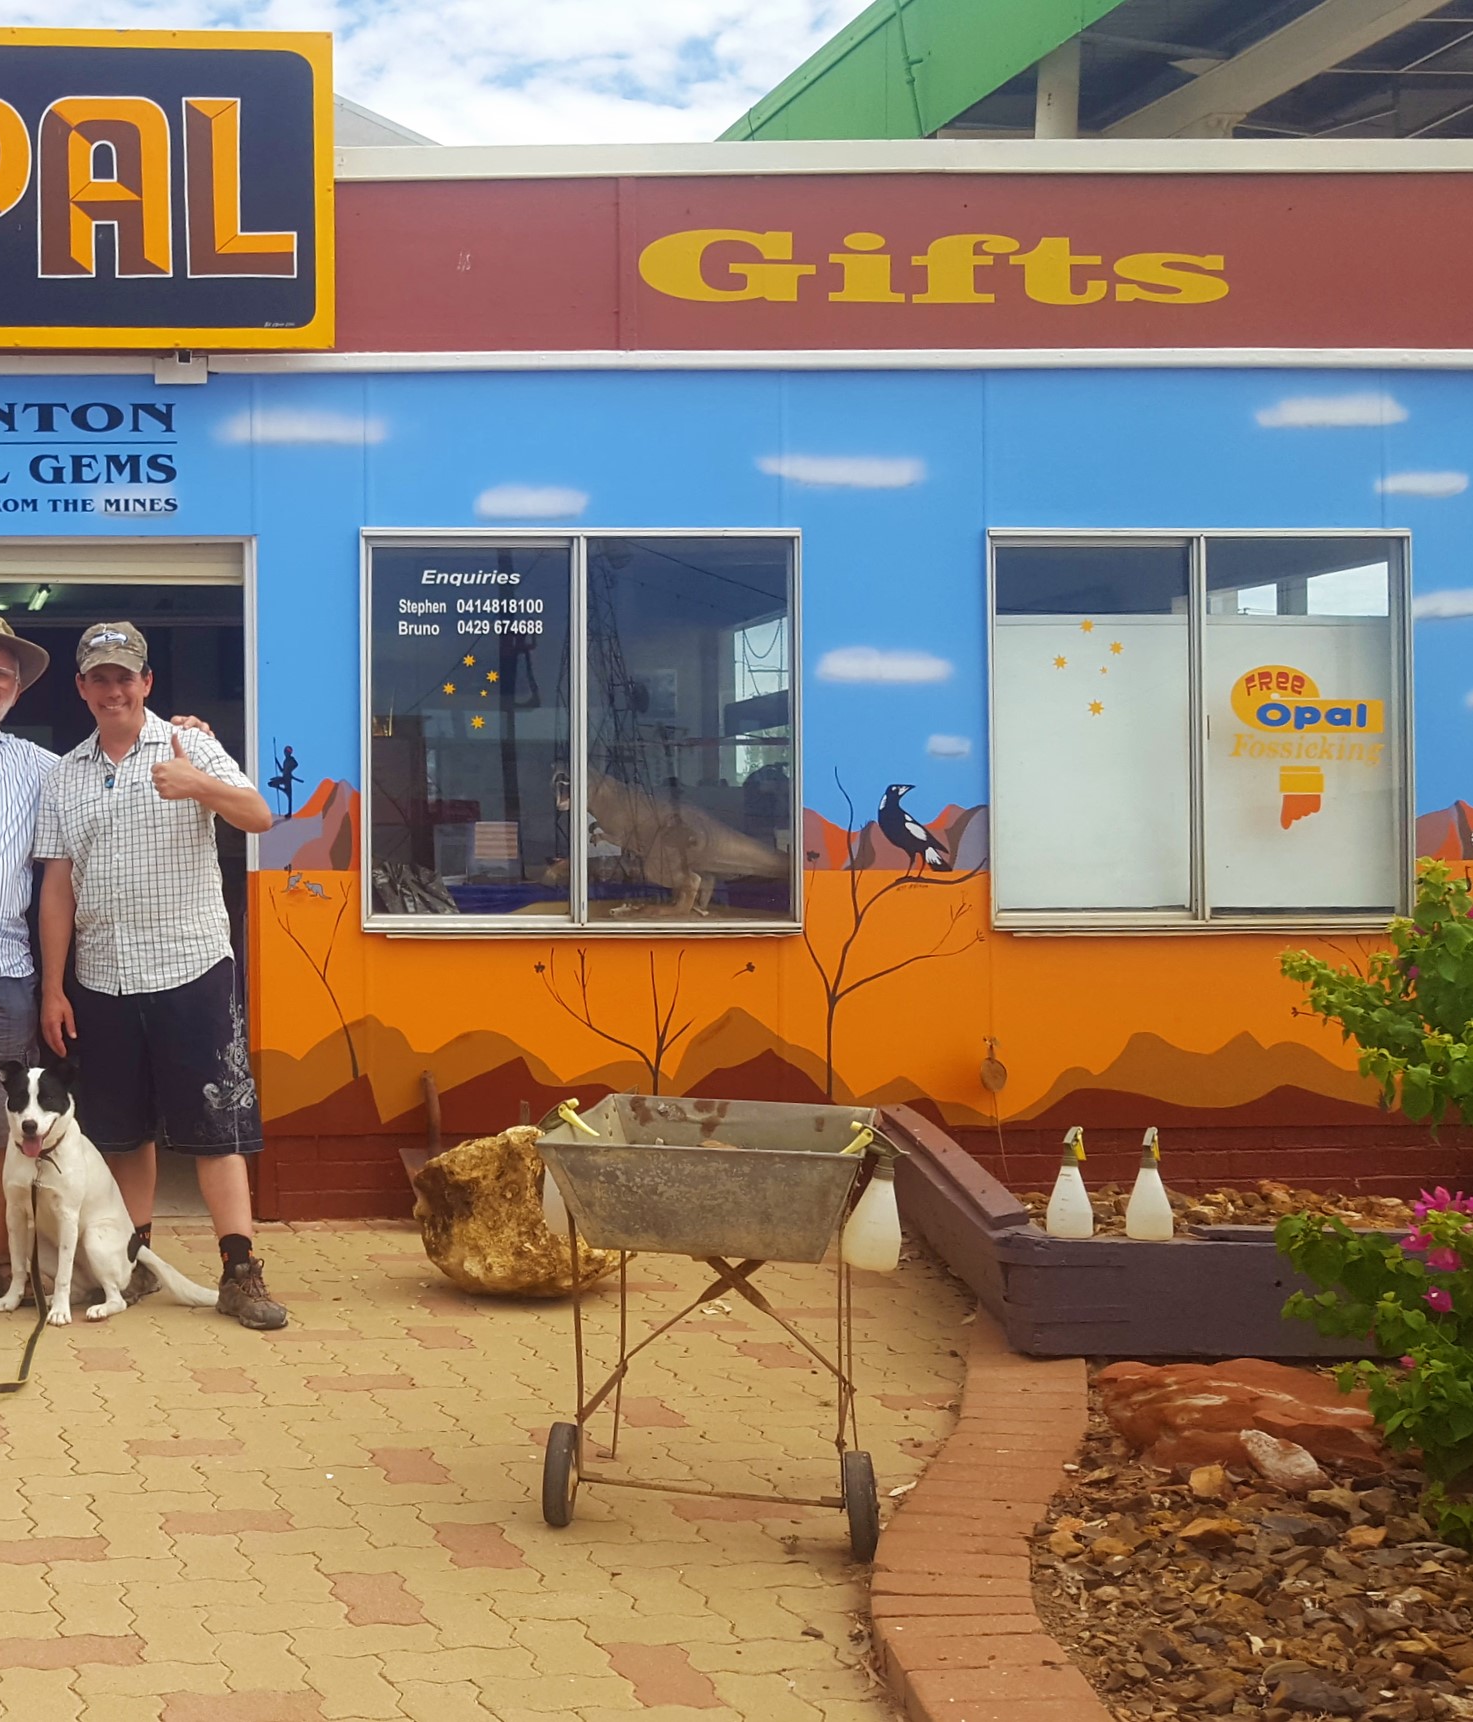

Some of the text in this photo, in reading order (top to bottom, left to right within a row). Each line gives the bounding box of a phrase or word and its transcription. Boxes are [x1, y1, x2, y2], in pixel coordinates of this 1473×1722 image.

[639, 229, 1230, 306] Gifts
[29, 454, 177, 484] GEMS
[48, 498, 95, 513] THE
[104, 498, 178, 513] MINES
[421, 569, 521, 587] Enquiries
[398, 598, 544, 617] Stephen 0414818100
[398, 619, 543, 636] Bruno 0429 674688
[1256, 702, 1367, 730] Opal
[1230, 734, 1386, 765] Fossicking
